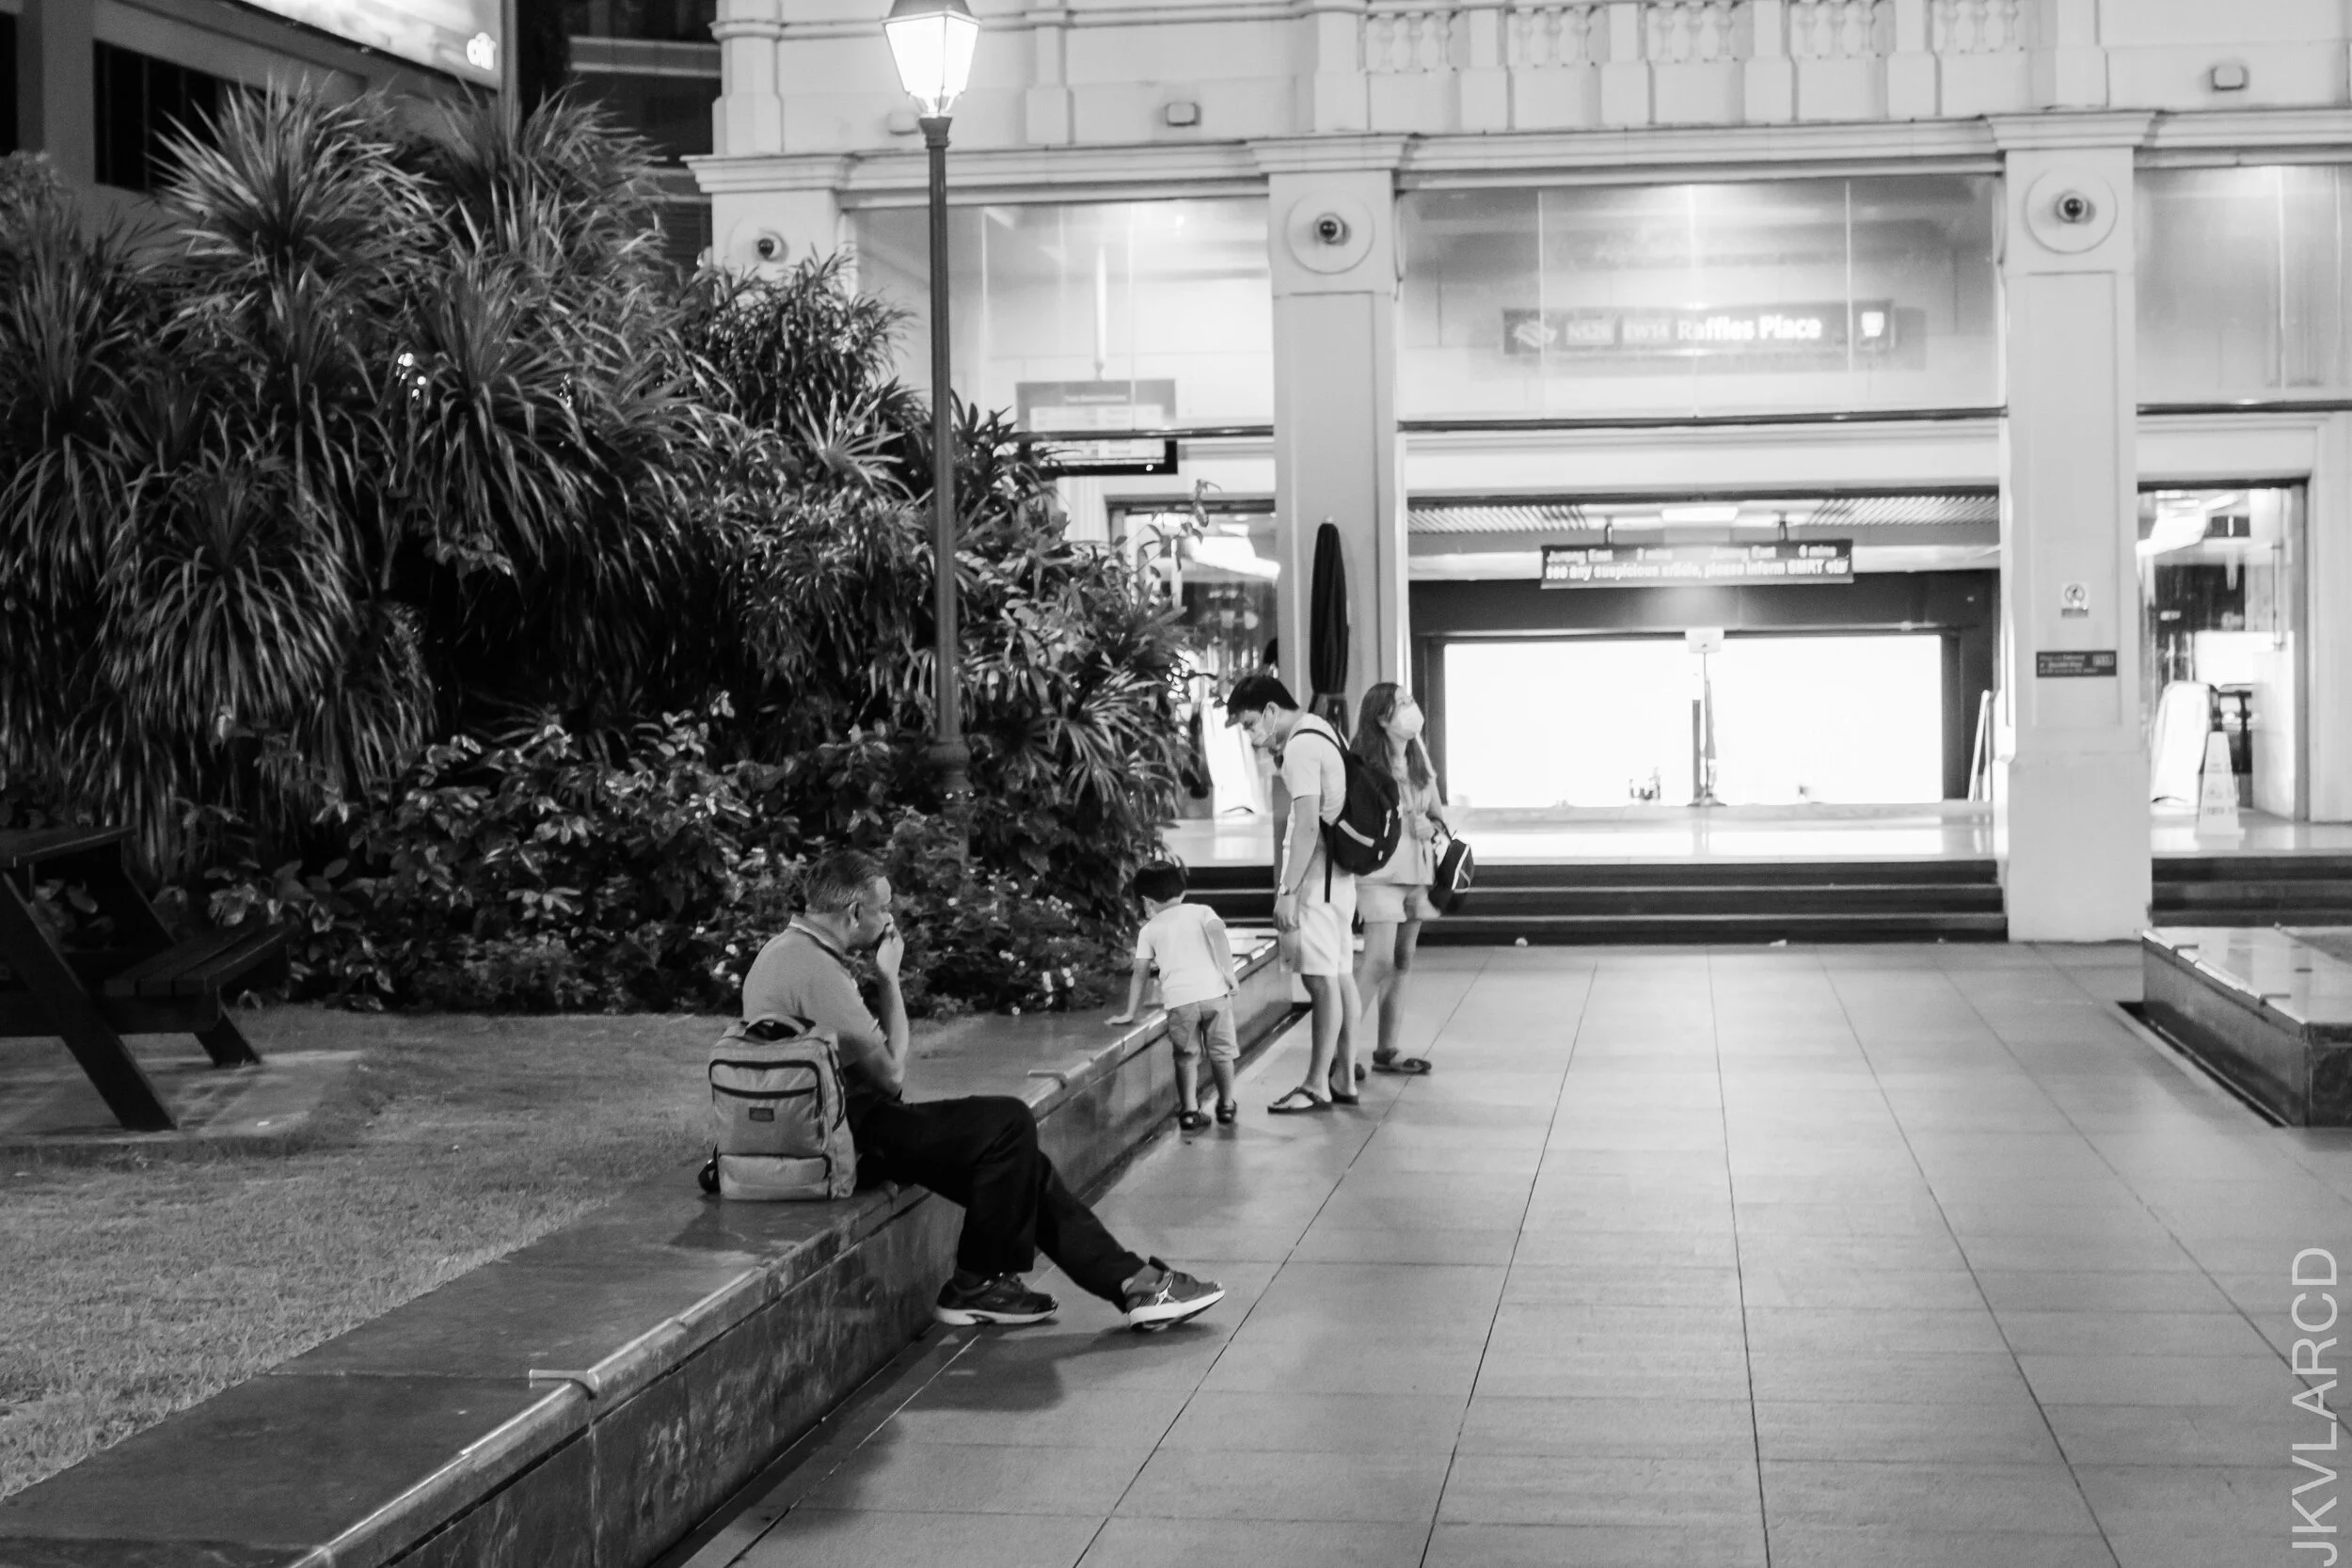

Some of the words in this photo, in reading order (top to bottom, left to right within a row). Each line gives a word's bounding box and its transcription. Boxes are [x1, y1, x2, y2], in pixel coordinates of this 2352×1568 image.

[1677, 316, 1754, 341] Raffles
[1758, 314, 1822, 340] Place
[1593, 562, 1660, 580] suspicious
[1704, 561, 1745, 578] please
[1746, 560, 1786, 576] inform
[1787, 559, 1824, 575] SMRT
